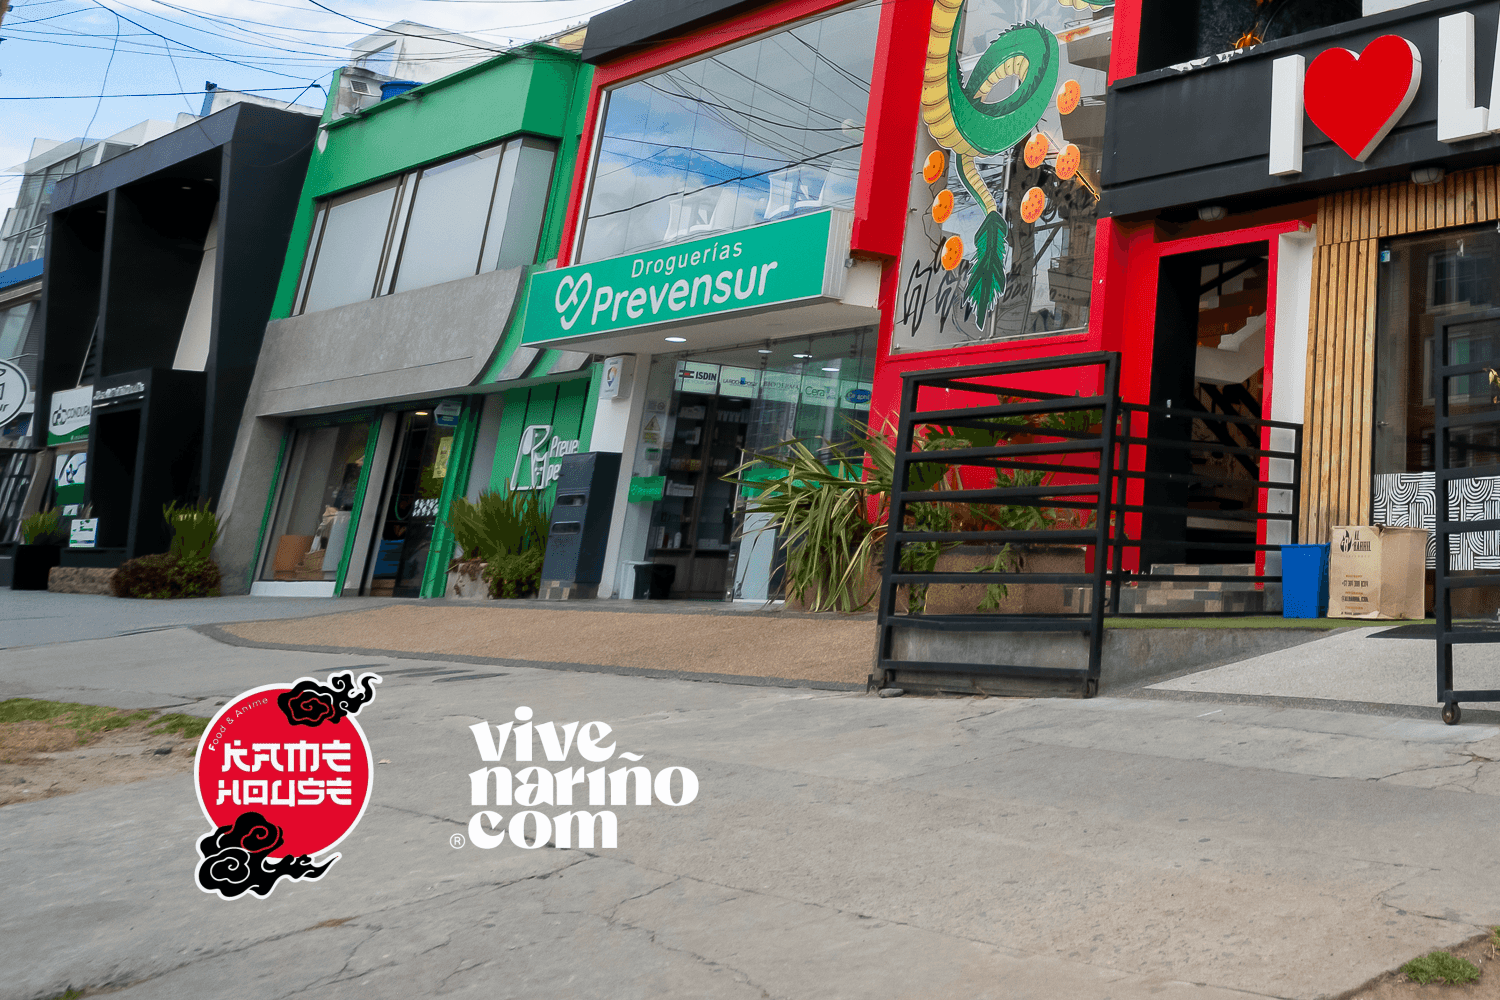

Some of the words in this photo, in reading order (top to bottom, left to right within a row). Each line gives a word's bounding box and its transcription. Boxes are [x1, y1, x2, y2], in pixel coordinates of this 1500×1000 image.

[1269, 52, 1305, 176] I
[631, 242, 743, 278] Droguerías
[591, 261, 778, 325] Prevensur
[695, 371, 717, 381] ISDIN
